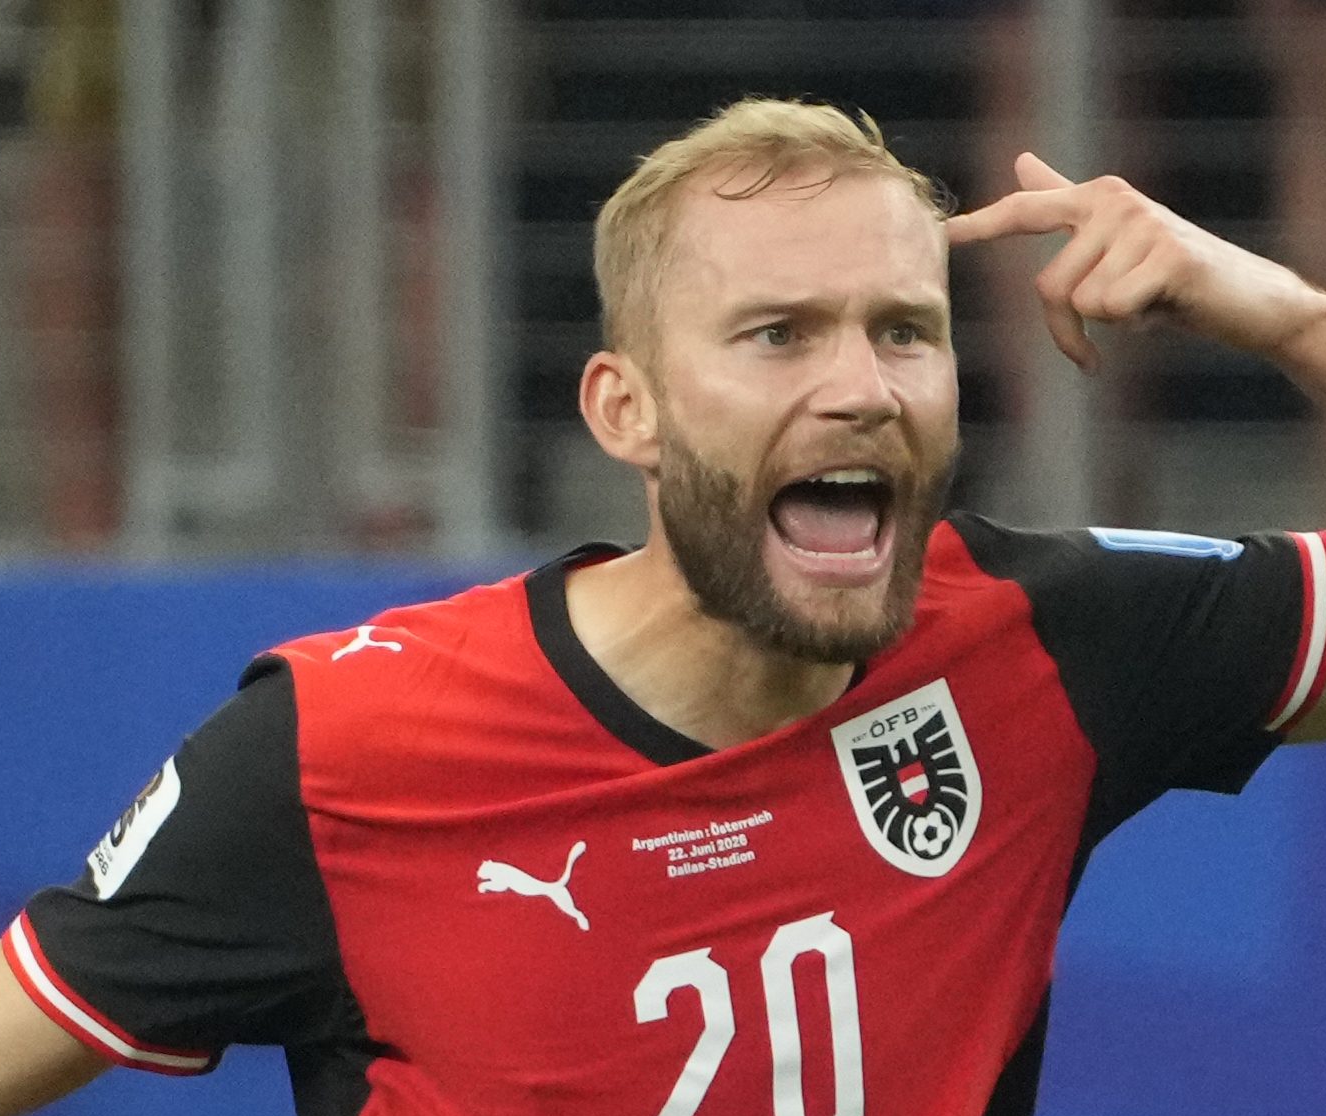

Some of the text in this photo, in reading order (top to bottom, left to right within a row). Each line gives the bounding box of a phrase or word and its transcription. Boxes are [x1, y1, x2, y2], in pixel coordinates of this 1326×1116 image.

[870, 707, 919, 738] ÖFB
[632, 828, 704, 851] Argentinien
[710, 810, 773, 836] Österreich
[668, 833, 748, 861] 22. Juni 2026
[667, 850, 756, 878] Dallas-Stadion
